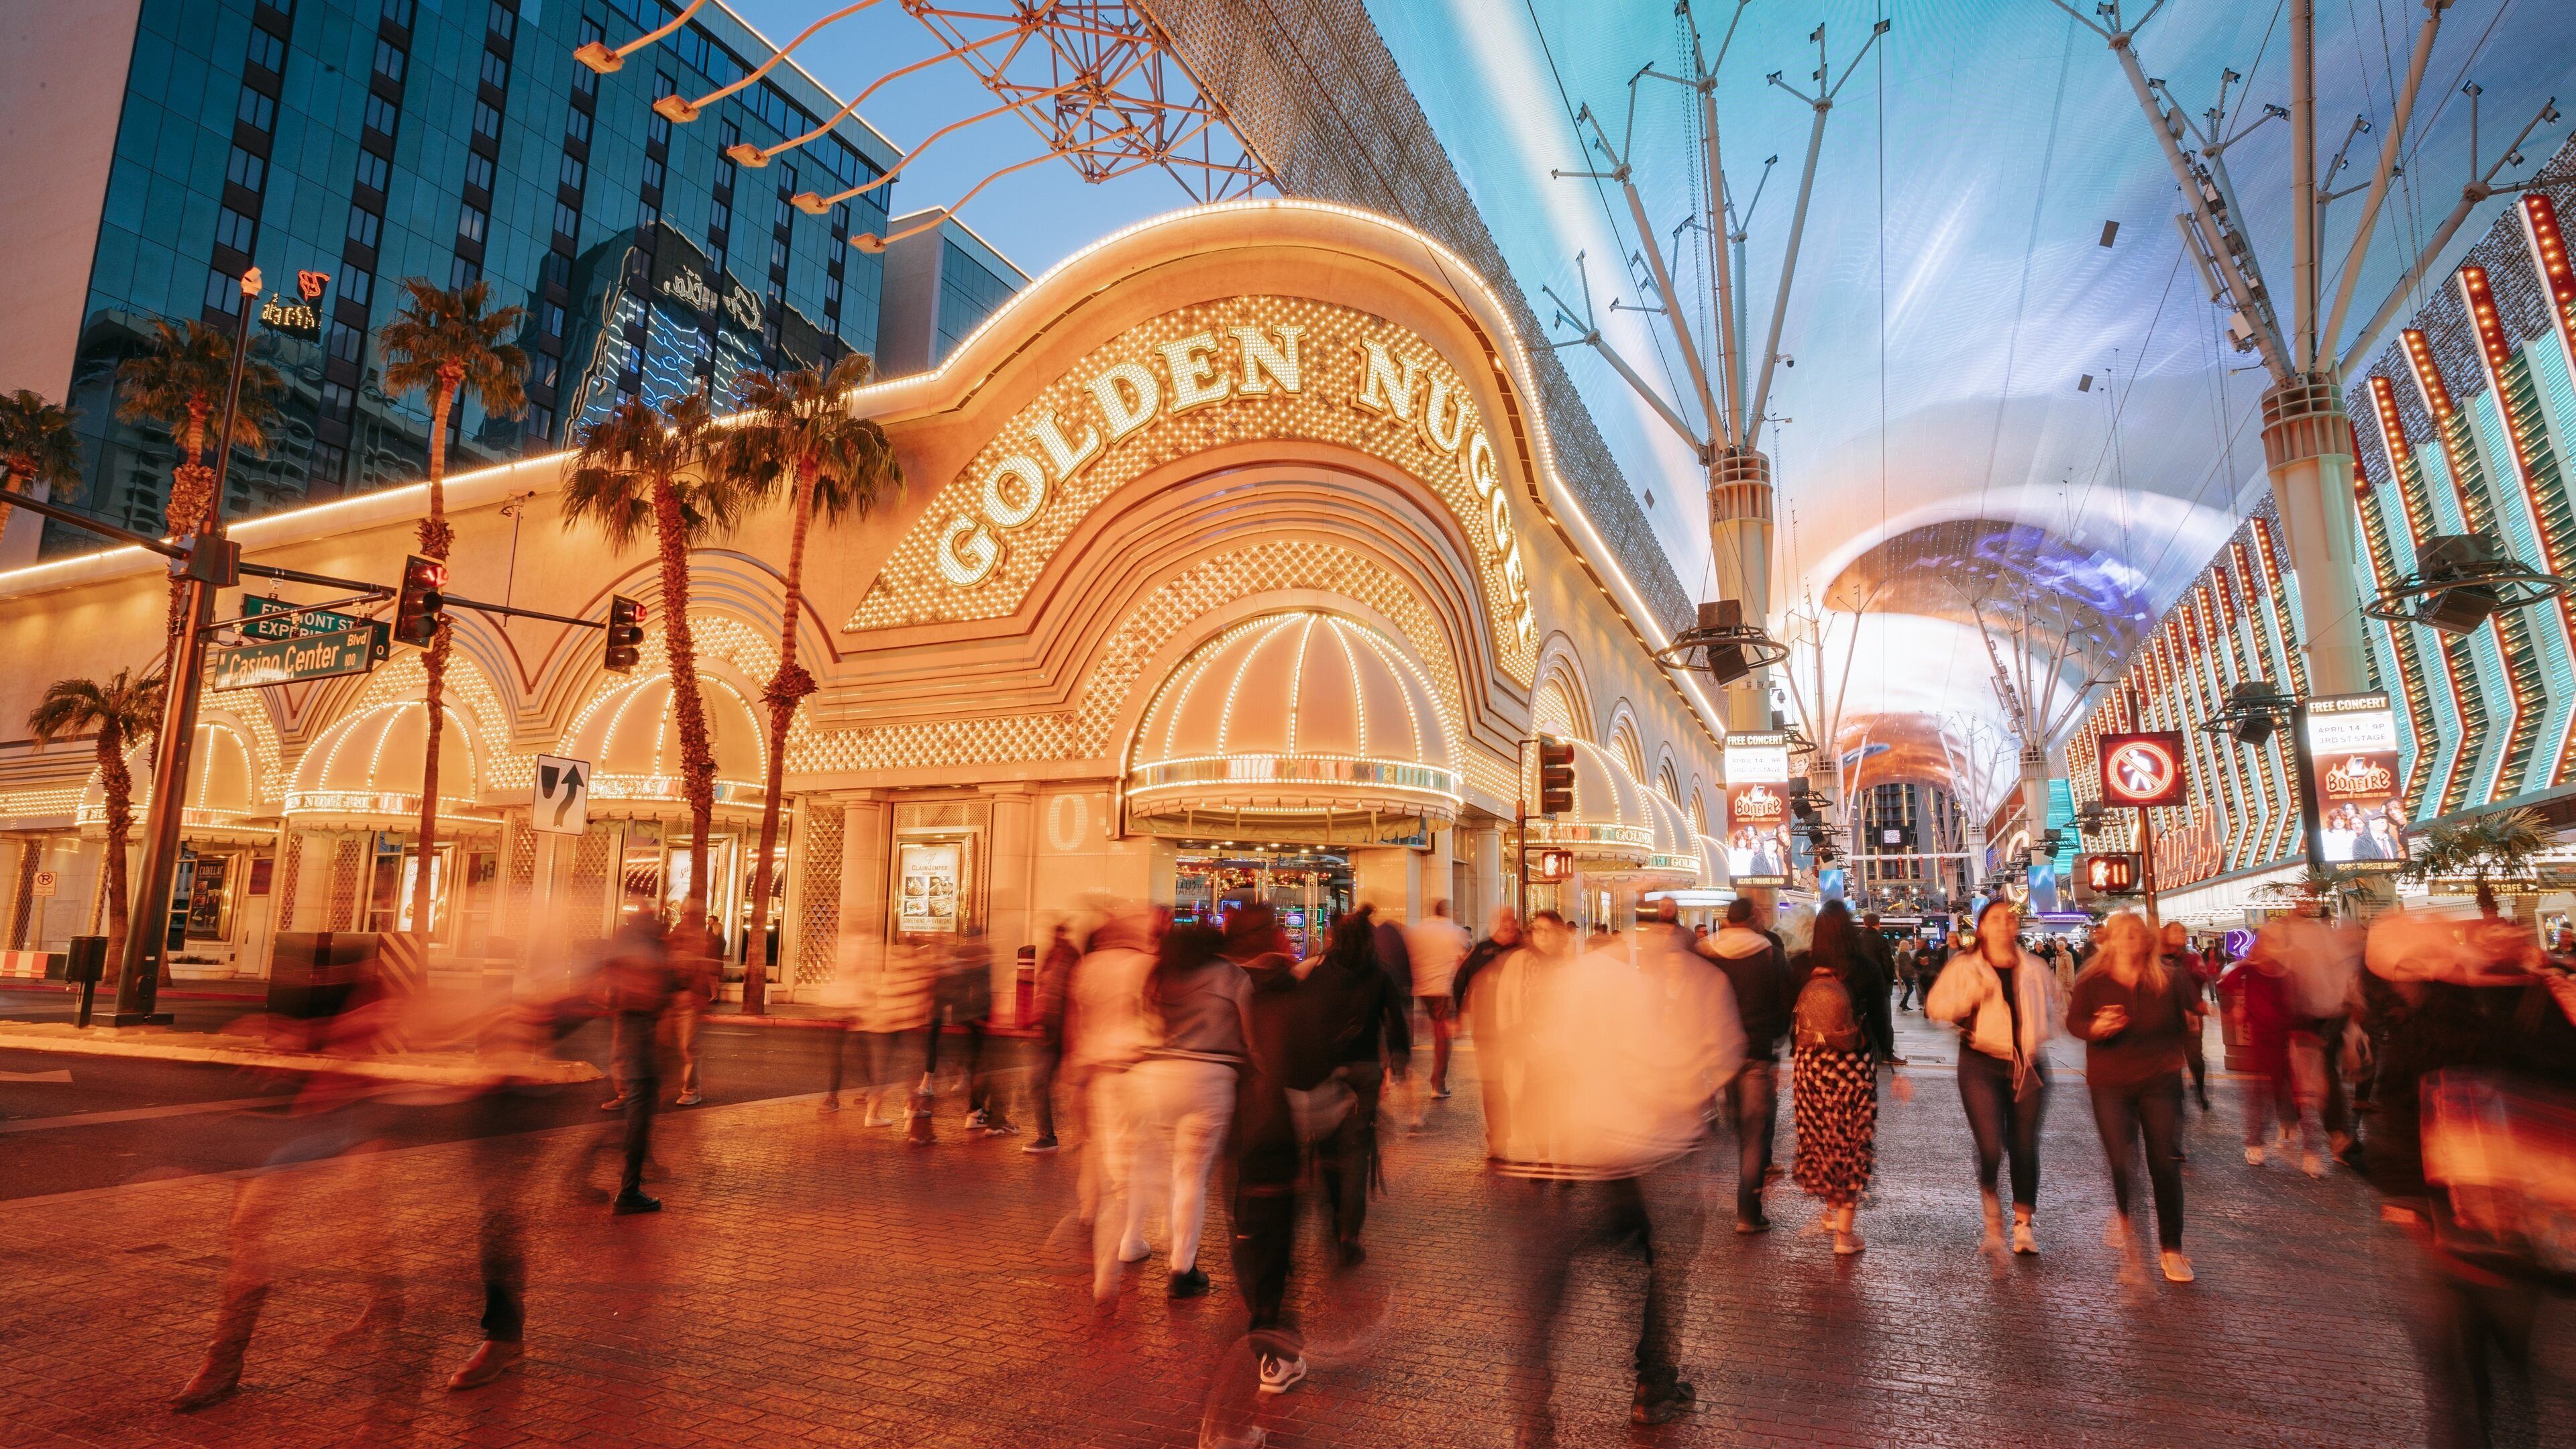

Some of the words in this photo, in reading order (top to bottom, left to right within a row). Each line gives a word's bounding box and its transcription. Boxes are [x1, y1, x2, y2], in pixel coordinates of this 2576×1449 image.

[937, 325, 1307, 588] GOLDEN
[1351, 335, 1536, 655] NUGGET
[347, 633, 368, 647] Blvd
[219, 653, 225, 665] N
[229, 651, 280, 678] Casino
[284, 643, 339, 672] Center
[344, 653, 356, 666] 100
[2310, 701, 2335, 712] FREE
[2337, 697, 2387, 710] CONCERT
[1727, 736, 1746, 745] FREE
[1747, 735, 1783, 745] CONCERT
[2501, 882, 2522, 892] CAFÉ
[2266, 909, 2290, 917] FIS
